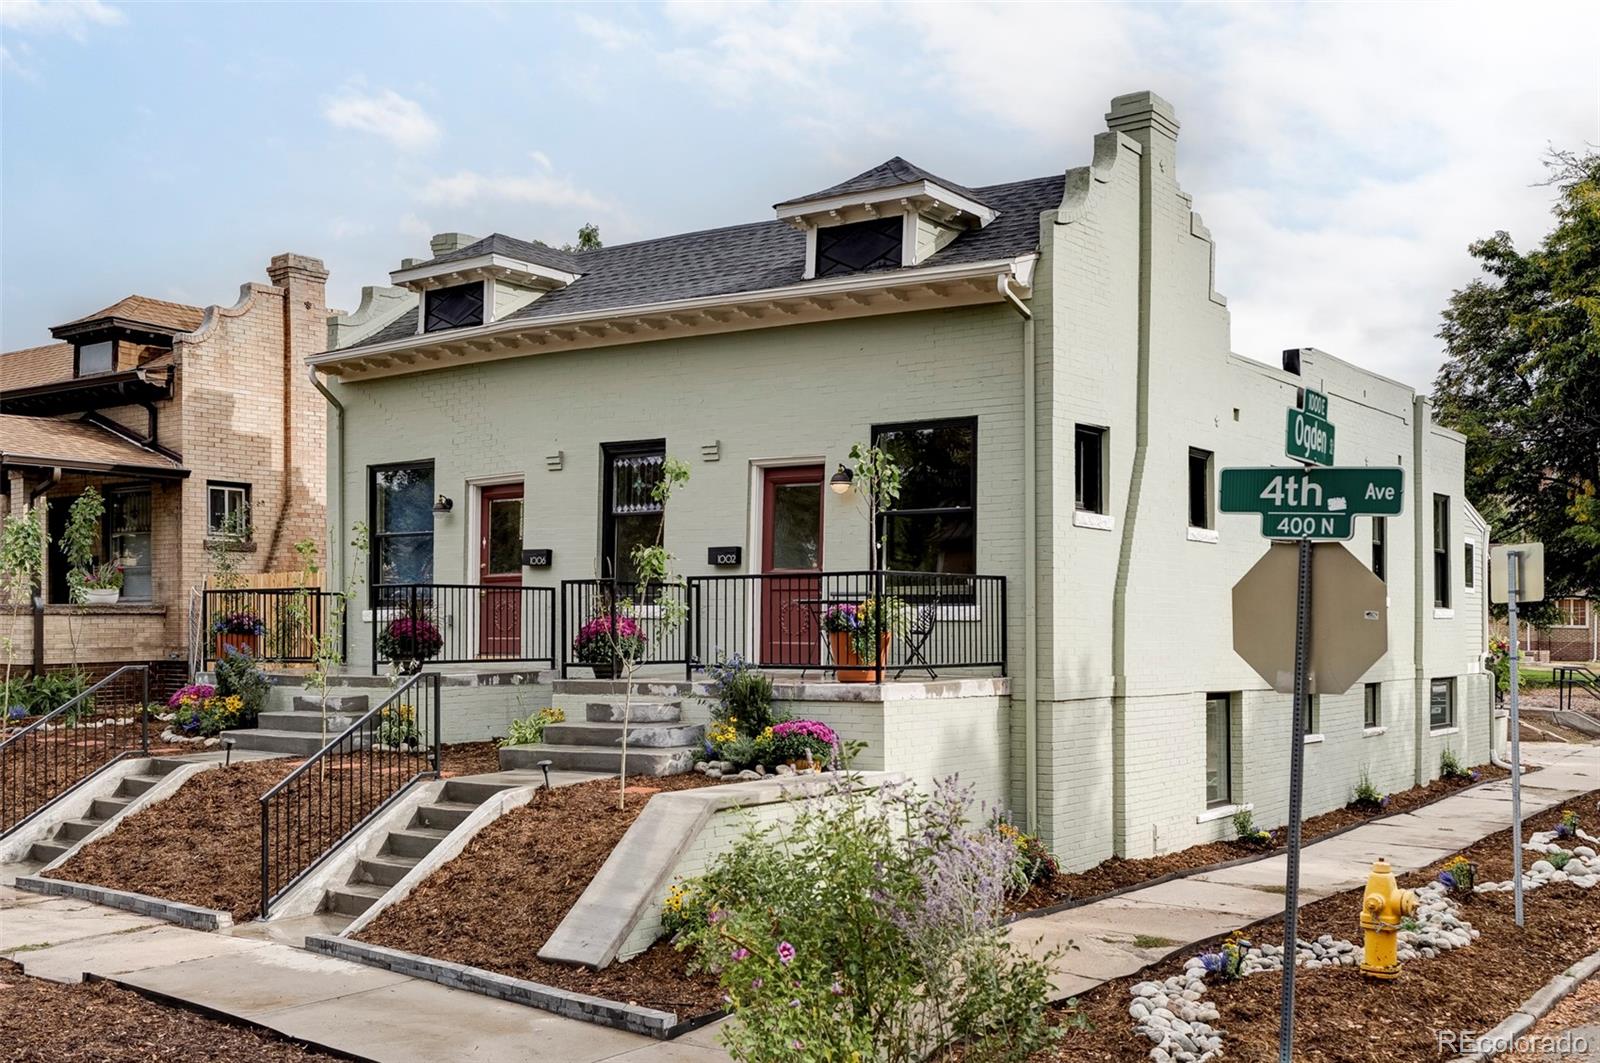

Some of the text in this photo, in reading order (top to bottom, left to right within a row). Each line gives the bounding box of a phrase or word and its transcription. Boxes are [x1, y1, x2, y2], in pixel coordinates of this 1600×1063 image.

[1295, 414, 1327, 457] Ogden
[1259, 475, 1395, 506] 4th Ave
[1277, 517, 1334, 535] 400 N
[530, 556, 546, 565] 1006
[717, 554, 736, 564] 1002
